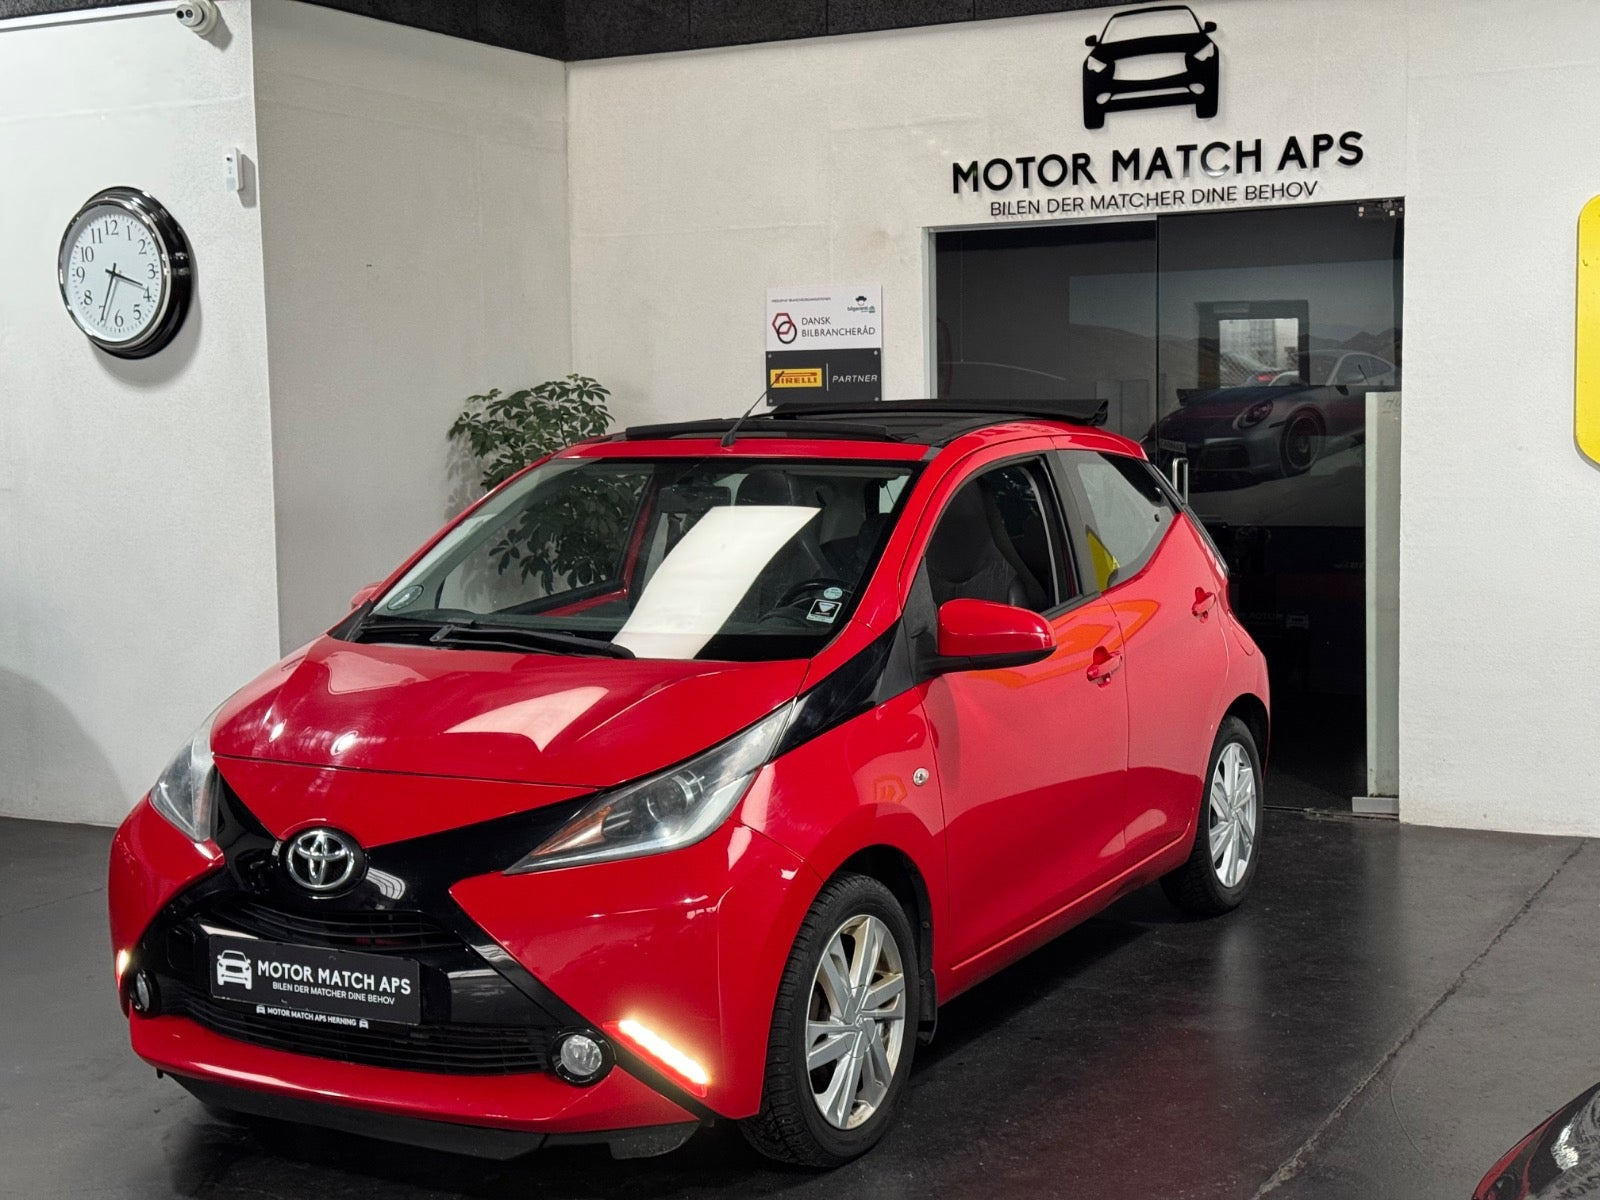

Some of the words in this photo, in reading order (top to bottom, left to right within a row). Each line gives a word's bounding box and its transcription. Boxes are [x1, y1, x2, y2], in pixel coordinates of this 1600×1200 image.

[953, 152, 1097, 194] MOTOR
[1112, 138, 1262, 182] MATCH
[1277, 131, 1364, 171] APS
[990, 200, 1040, 216] BILEN
[1047, 197, 1084, 213] DER
[1090, 190, 1185, 210] MATCHER
[1192, 185, 1237, 204] DINE
[1245, 180, 1318, 201] BEHOV
[90, 228, 103, 244] 11
[104, 219, 119, 236] 12
[126, 225, 132, 241] 1
[80, 246, 94, 263] 10
[138, 239, 147, 255] 2
[76, 266, 85, 284] 9
[147, 263, 156, 280] 3
[83, 289, 93, 306] 8
[143, 286, 152, 302] 4
[114, 309, 124, 327] 6
[132, 304, 142, 320] 5
[801, 317, 831, 325] DANSK
[801, 324, 876, 337] BILBRANCHERÅD
[832, 375, 878, 383] PARTNER
[257, 960, 314, 983] MOTOR
[318, 968, 375, 991] MATCH
[379, 976, 411, 995] APS
[272, 981, 293, 992] BILEN
[294, 984, 309, 994] DER
[310, 986, 347, 999] MATCHER
[348, 991, 366, 1001] DINE
[367, 994, 395, 1005] BEHOV
[267, 1007, 290, 1017] MOTOR
[291, 1010, 314, 1020] MATCH
[314, 1014, 327, 1022] APS
[327, 1015, 357, 1026] HERNING
